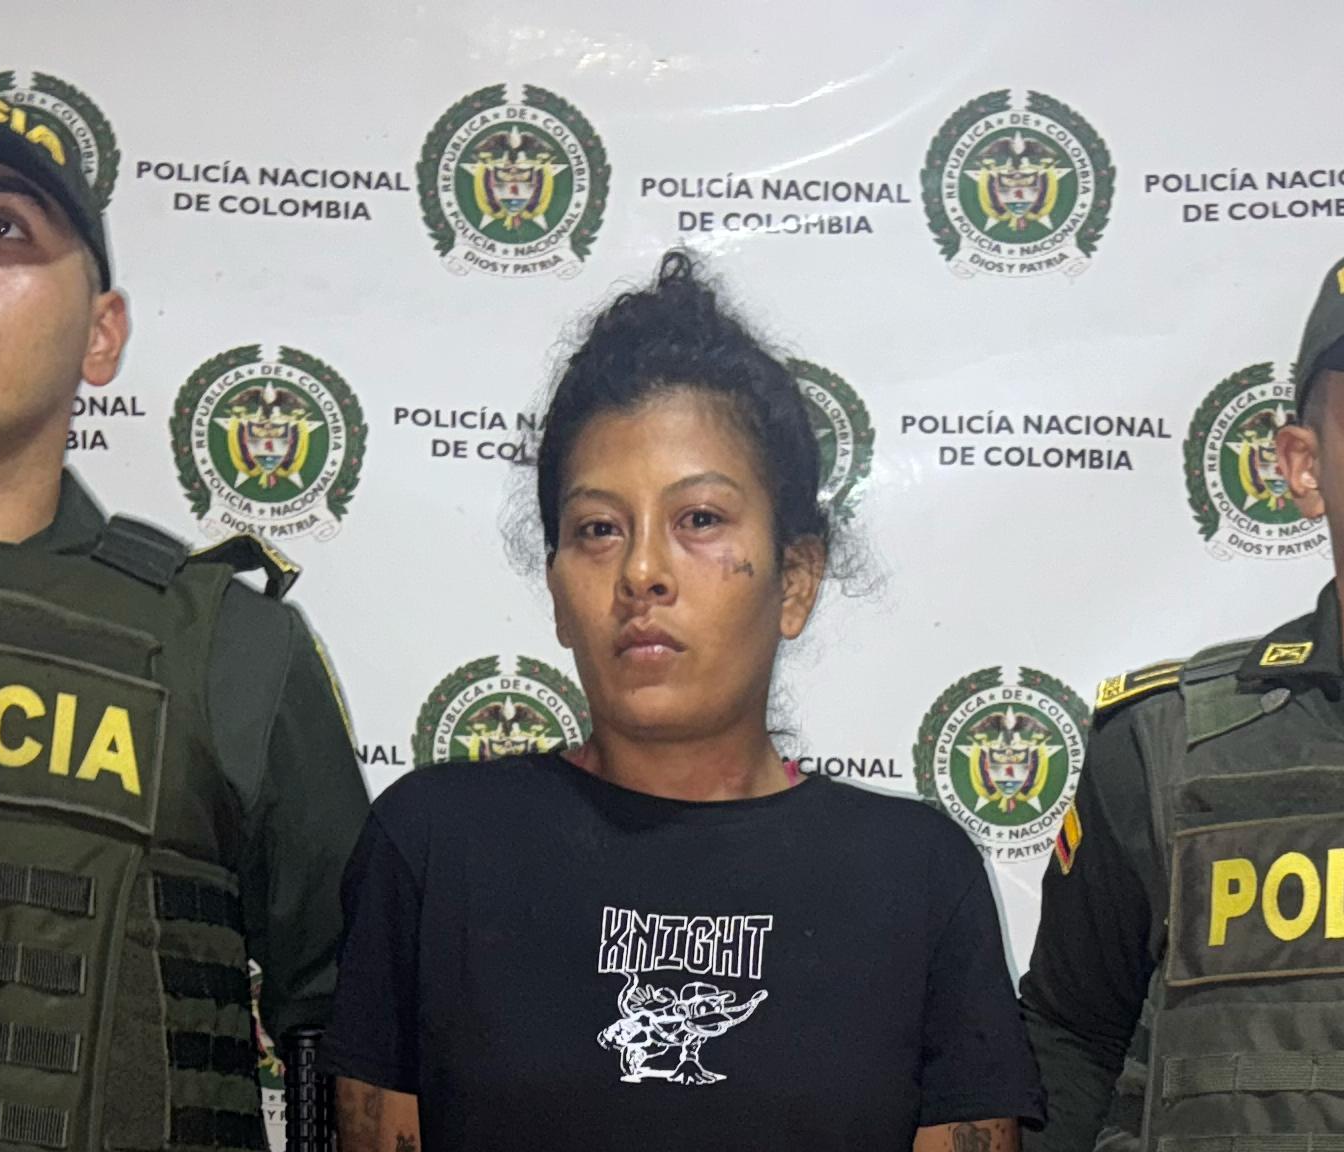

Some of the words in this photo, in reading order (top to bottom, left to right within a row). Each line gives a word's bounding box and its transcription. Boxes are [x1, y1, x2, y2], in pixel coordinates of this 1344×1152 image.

[506, 109, 528, 121] DE
[540, 117, 587, 195] COLOMBIA
[1009, 116, 1031, 127] DE
[1043, 123, 1091, 195] COLOMBIA
[136, 160, 251, 185] POLICÍA
[259, 167, 411, 192] NACIONAL
[641, 172, 754, 200] POLICÍA
[761, 178, 911, 204] NACIONAL
[1145, 167, 1259, 193] POLICÍA
[173, 192, 211, 213] DE
[218, 195, 371, 221] COLOMBIA
[1183, 203, 1219, 223] DE
[514, 210, 581, 256] NACIONAL
[678, 210, 715, 232] DE
[722, 212, 874, 235] COLOMBIA
[1020, 210, 1086, 256] NACIONAL
[513, 255, 563, 275] PATRIA
[1019, 253, 1070, 274] PATRIA
[1272, 386, 1294, 398] DE
[260, 364, 282, 376] DE
[295, 373, 343, 453] COLOMBIA
[394, 406, 508, 431] POLICÍA
[901, 409, 1015, 435] POLICÍA
[1023, 414, 1172, 439] NACIONAL
[431, 438, 468, 459] DE
[939, 445, 975, 466] DE
[984, 446, 1133, 471] COLOMBIA
[270, 468, 337, 515] NACIONAL
[269, 514, 320, 535] PATRIA
[1277, 535, 1327, 557] PATRIA
[499, 679, 521, 691] DE
[537, 688, 578, 742] COLOM
[1002, 689, 1024, 701] DE
[1036, 697, 1080, 776] COLOMBIA
[1008, 791, 1074, 839] NACIONAL
[1007, 837, 1056, 858] PATRIA
[598, 906, 773, 979] KNIGHT
